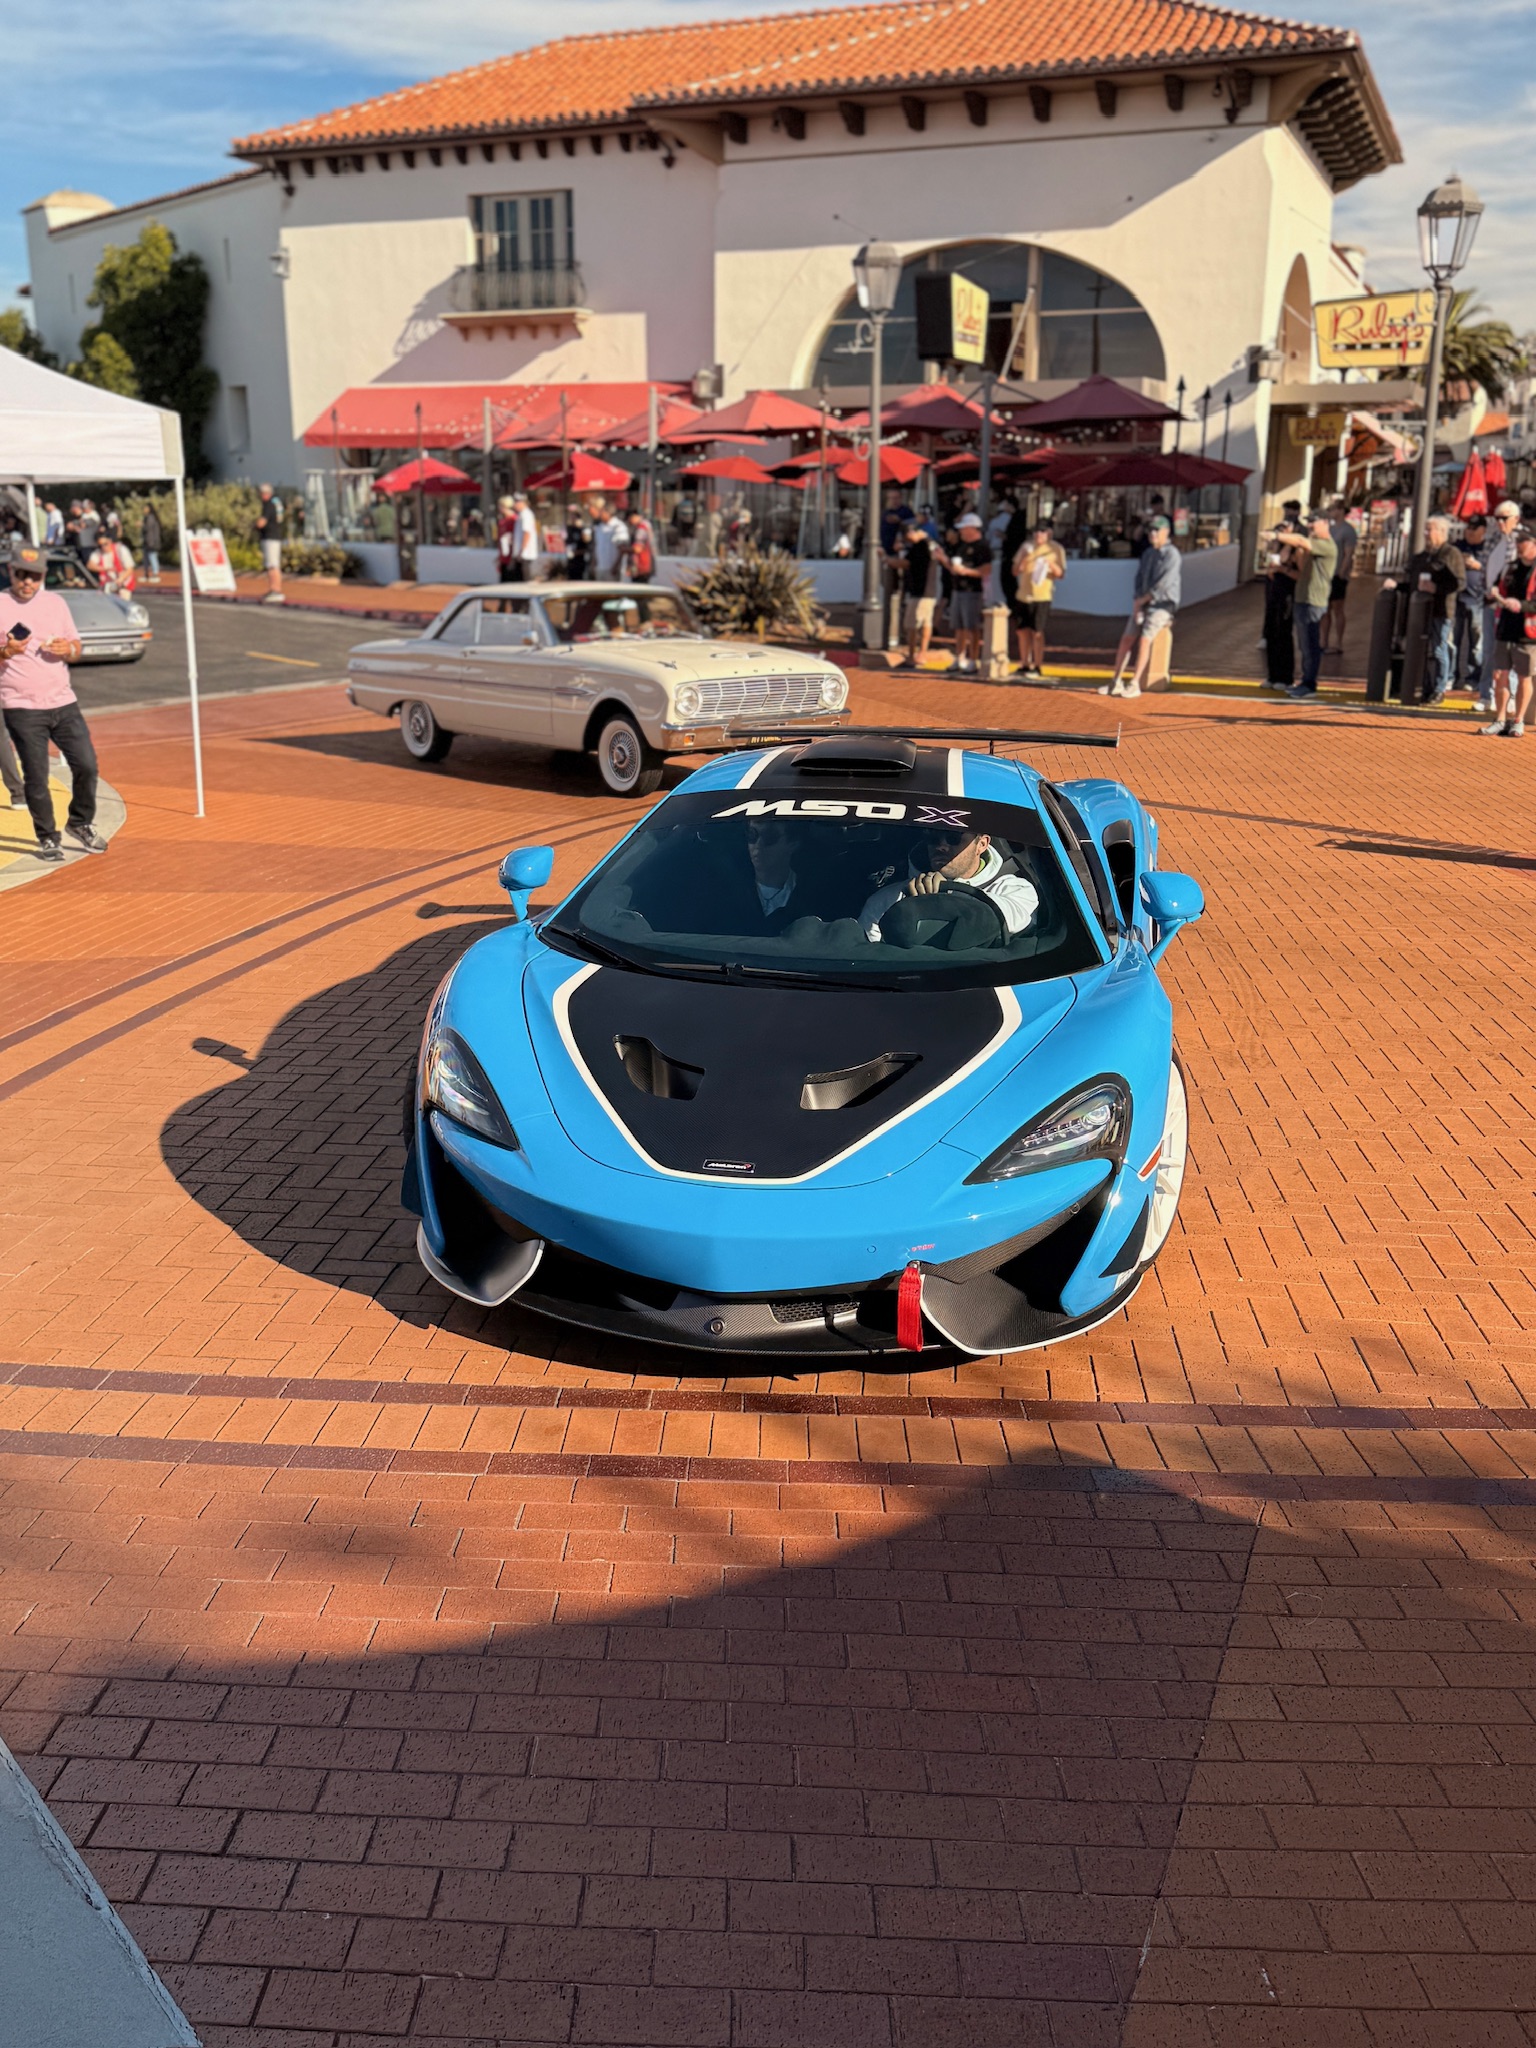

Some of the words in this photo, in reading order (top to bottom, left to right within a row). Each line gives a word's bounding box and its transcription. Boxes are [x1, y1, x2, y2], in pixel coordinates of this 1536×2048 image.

[1331, 301, 1426, 362] Ruby's
[711, 799, 906, 821] MSO
[914, 805, 972, 828] X
